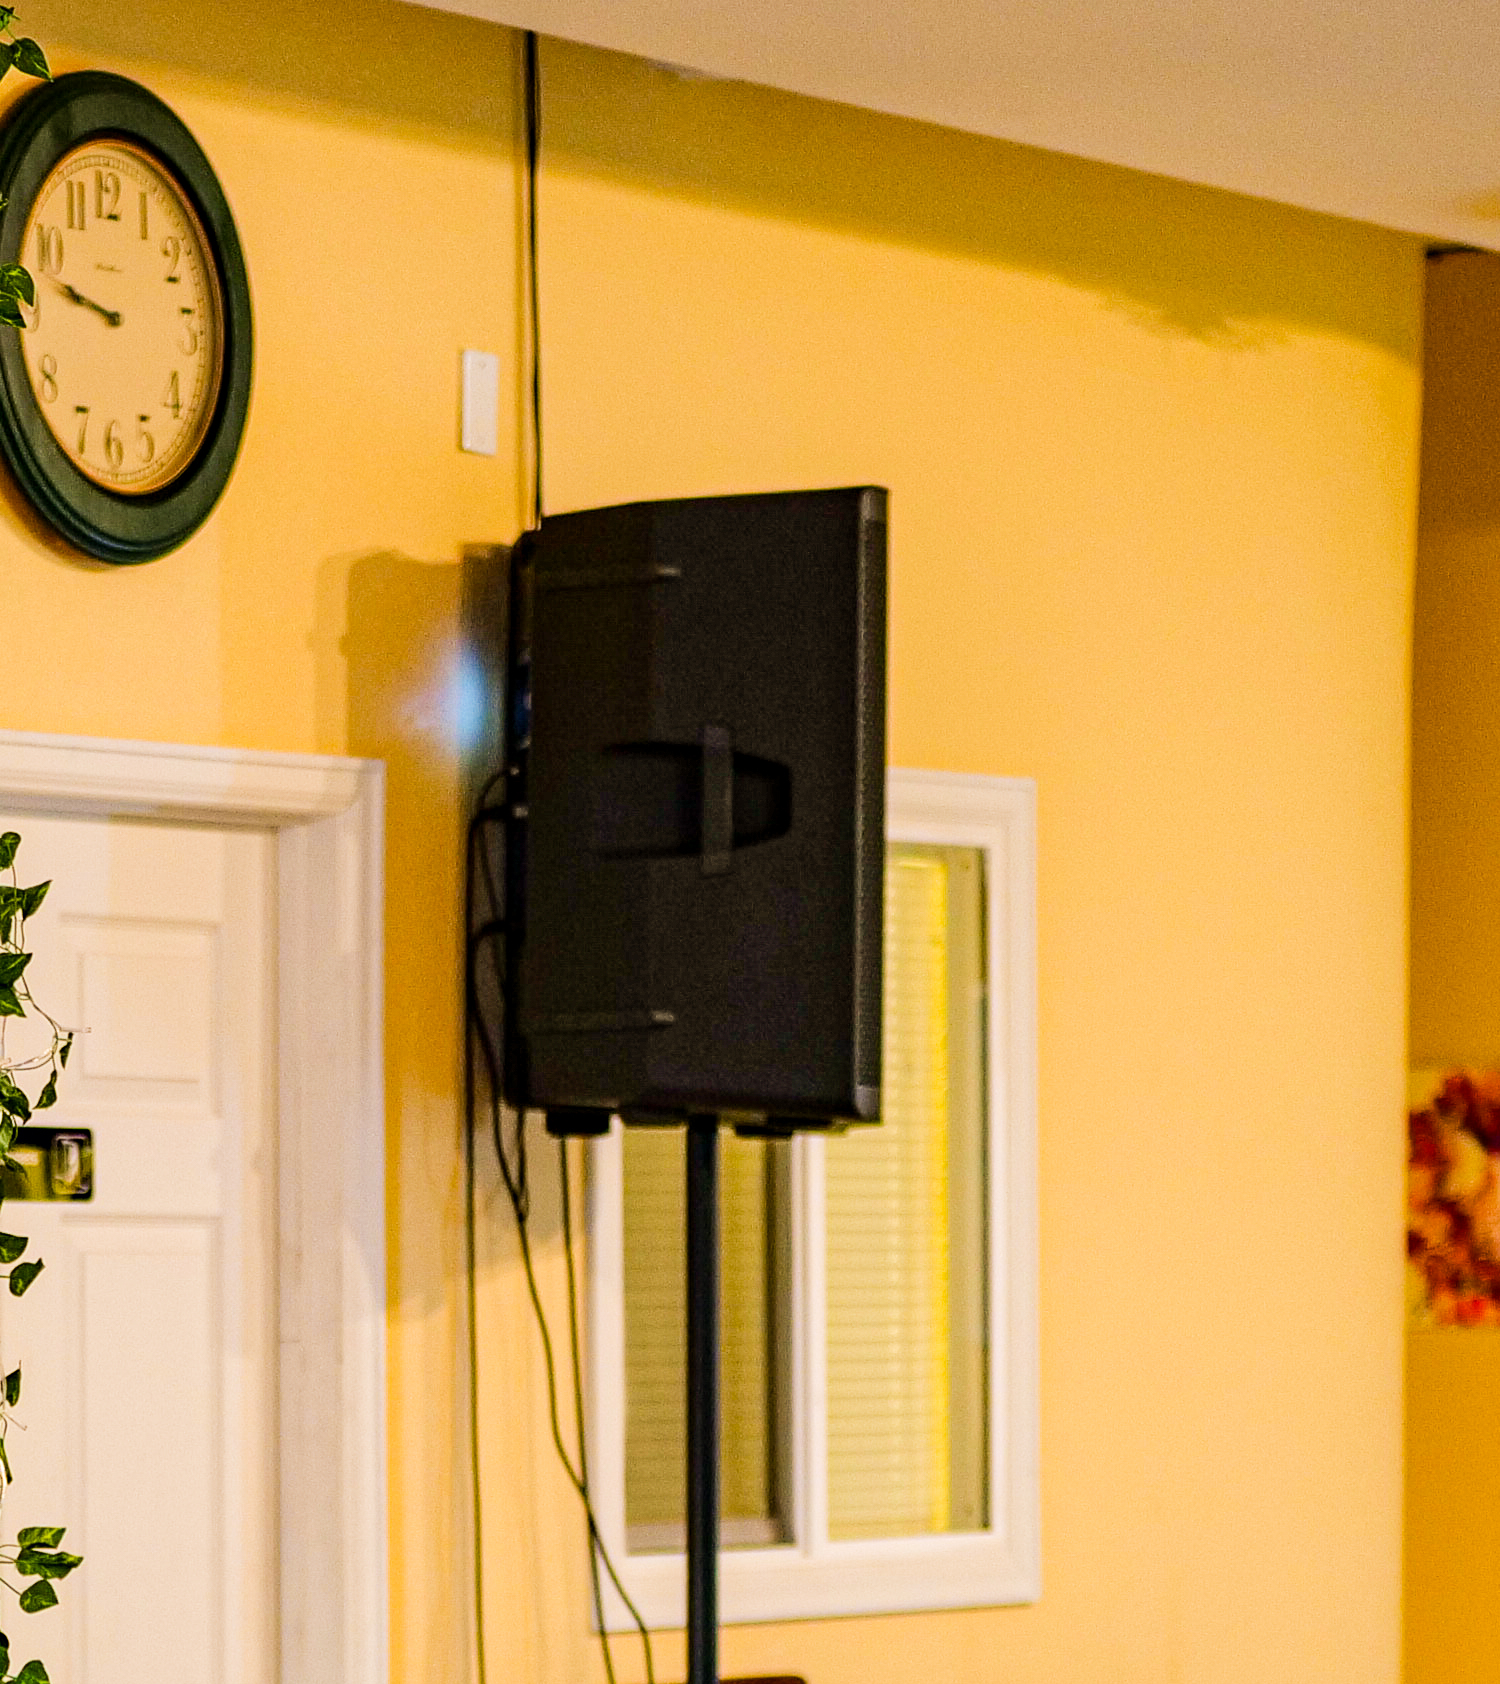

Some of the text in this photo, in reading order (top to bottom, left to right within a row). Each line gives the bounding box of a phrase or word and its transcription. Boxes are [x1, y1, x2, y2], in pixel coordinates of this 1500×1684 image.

[65, 179, 87, 231] 11
[94, 169, 123, 222] 12
[136, 191, 150, 240] 1
[35, 222, 66, 275] 10
[160, 235, 184, 283] 2
[39, 353, 60, 404] 8
[162, 370, 184, 421] 4
[73, 405, 91, 456] 7
[103, 418, 125, 469] 6
[136, 413, 156, 464] 5
